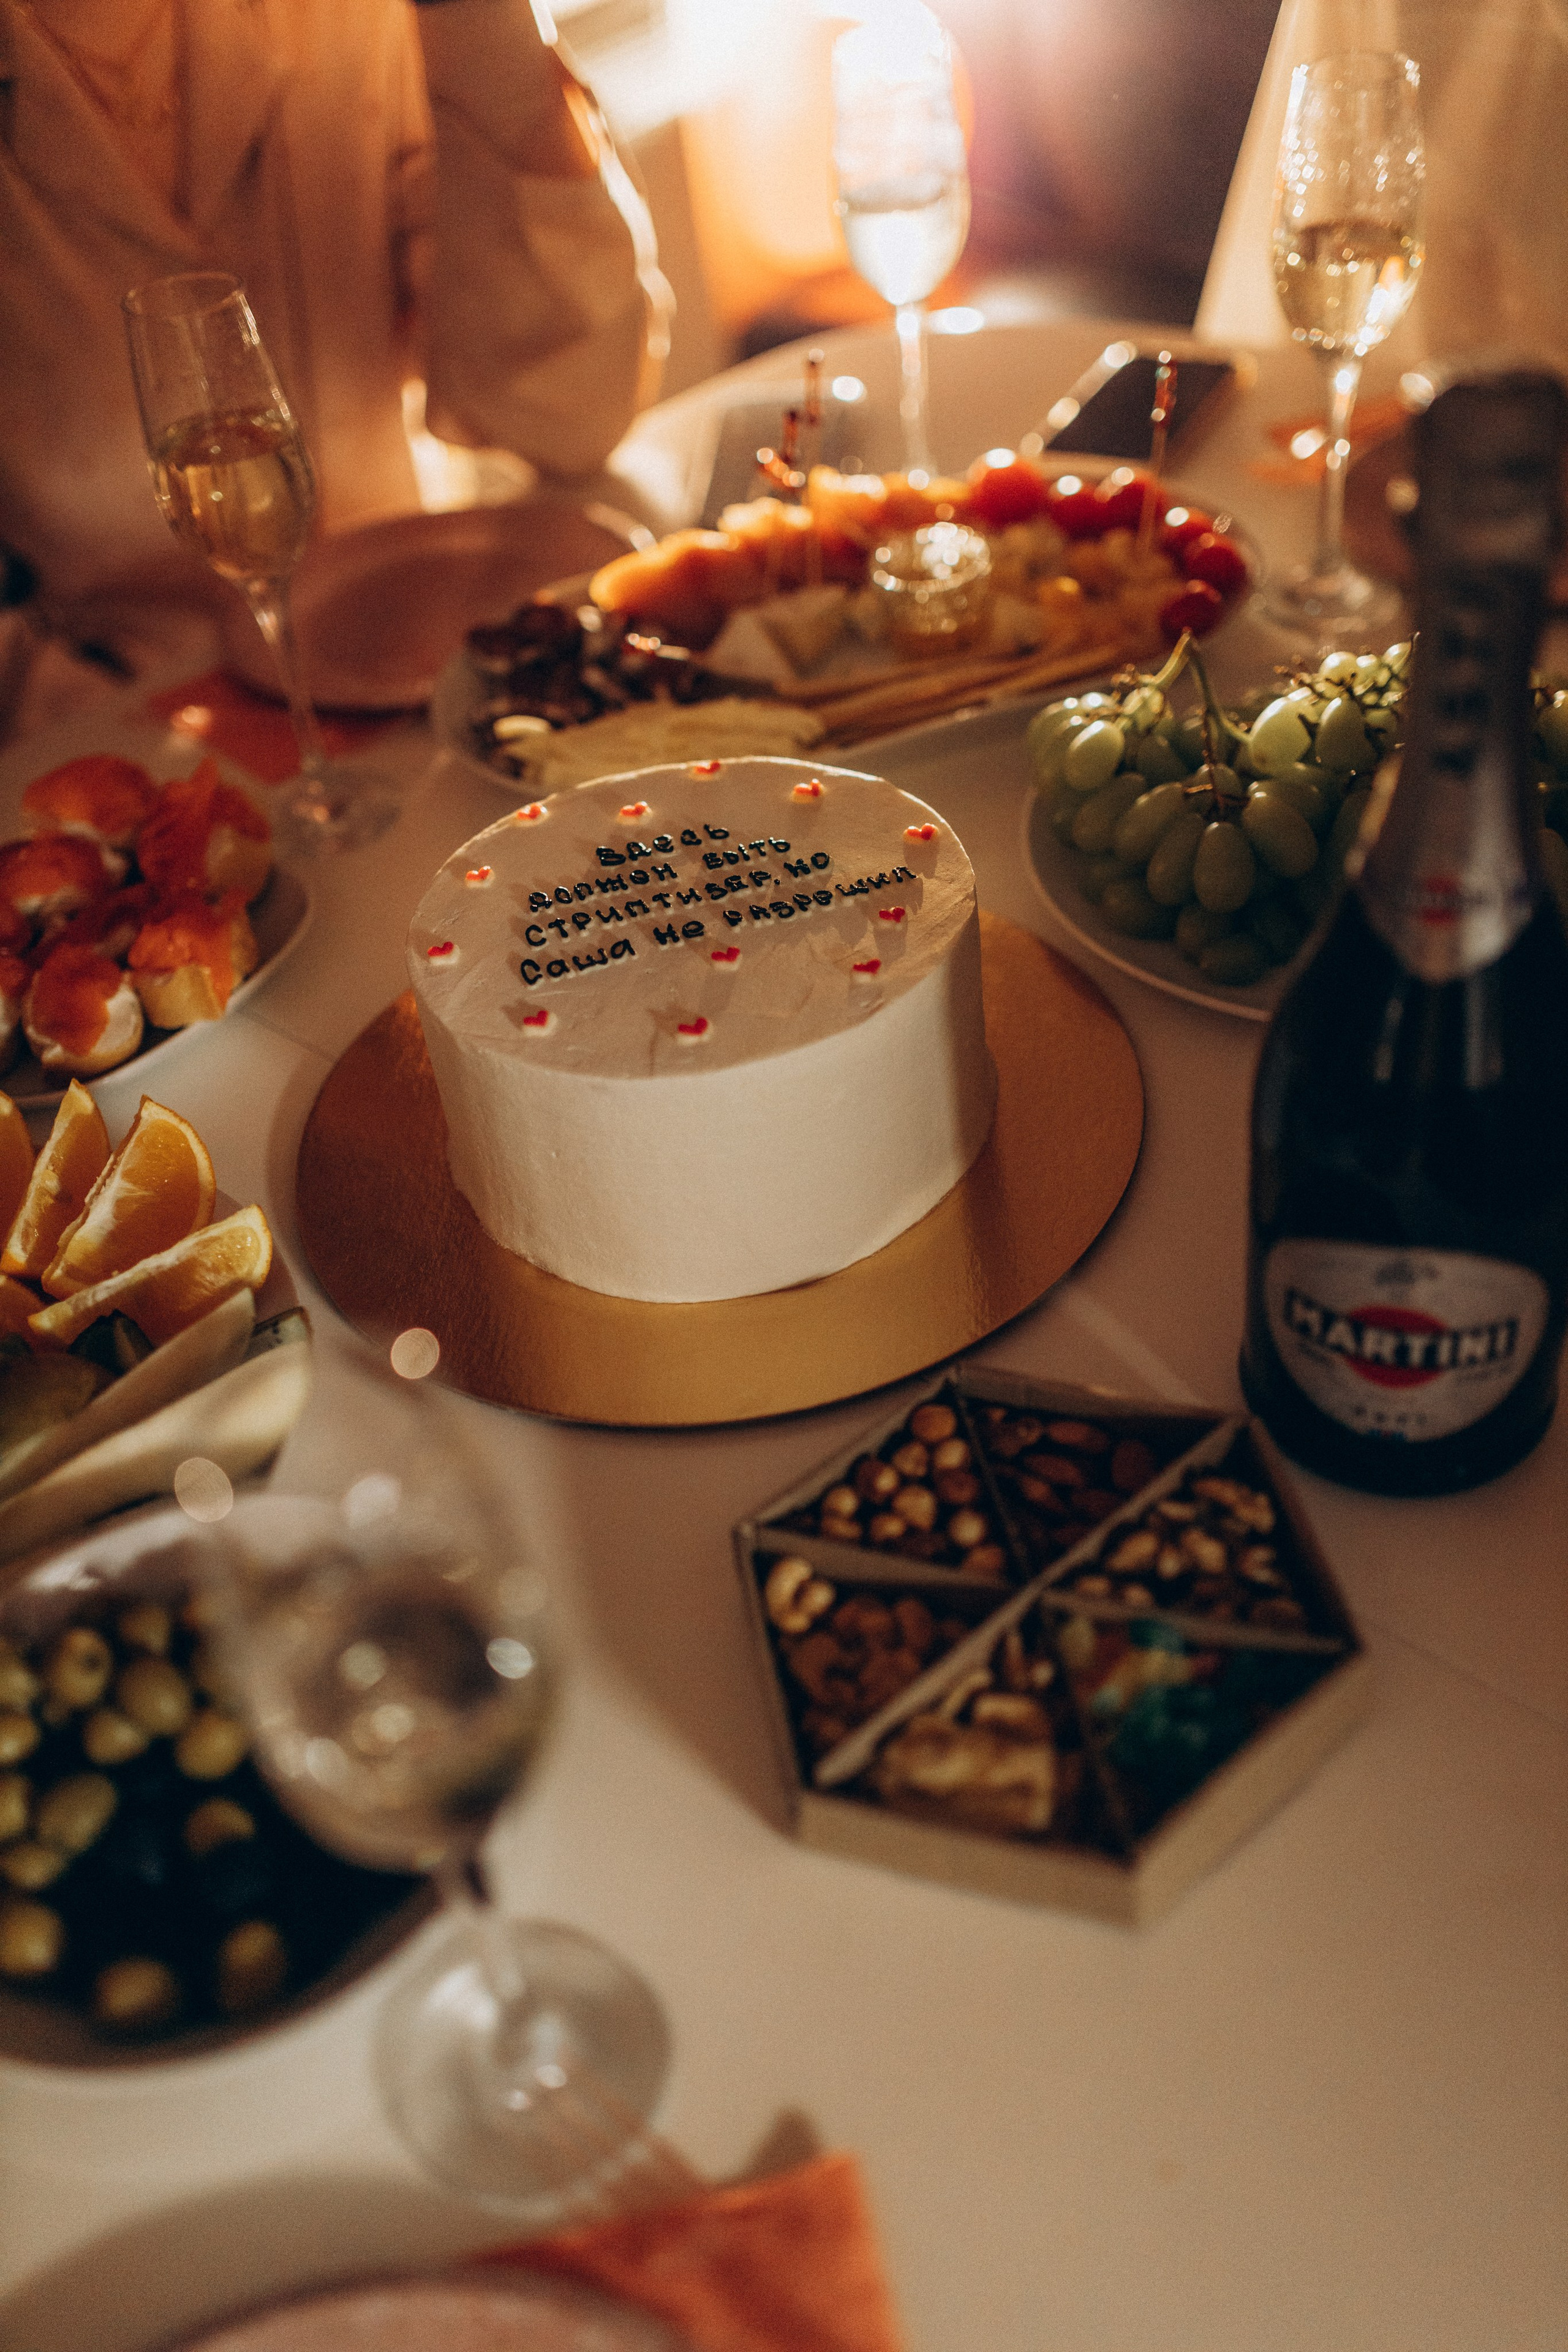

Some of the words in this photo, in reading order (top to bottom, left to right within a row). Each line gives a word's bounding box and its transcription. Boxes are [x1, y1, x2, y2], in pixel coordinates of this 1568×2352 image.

[521, 939, 636, 985] Саша
[653, 921, 704, 944] не
[1286, 1290, 1519, 1368] MARTINI
